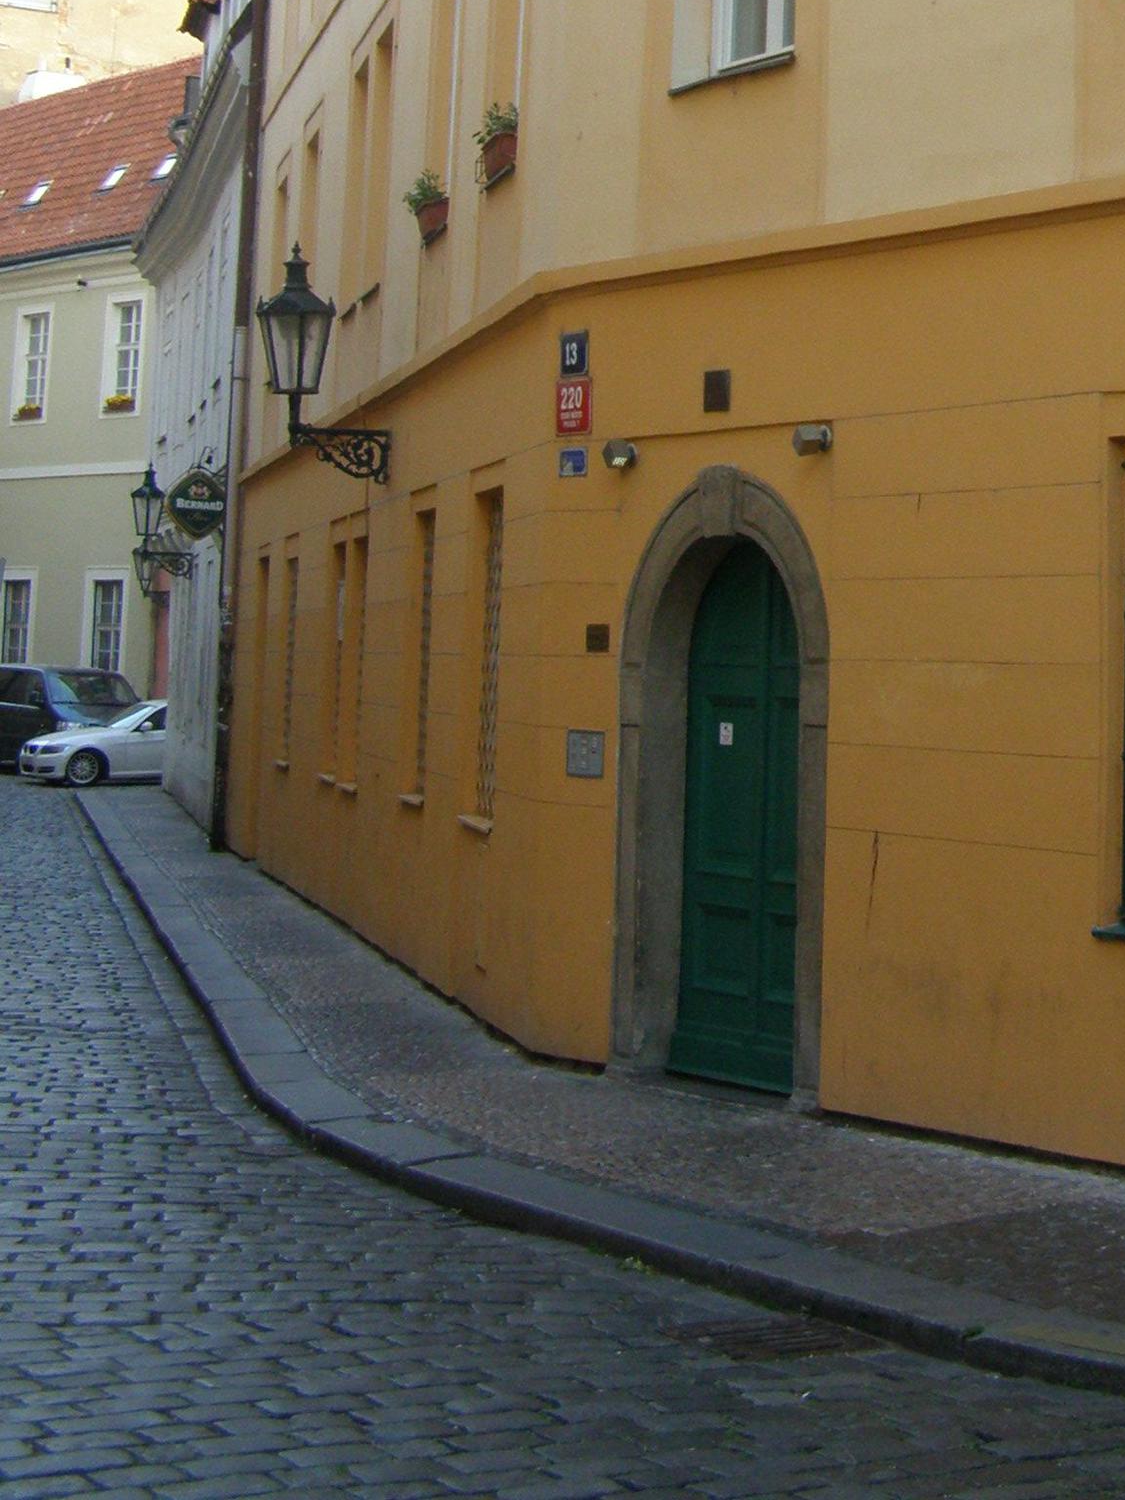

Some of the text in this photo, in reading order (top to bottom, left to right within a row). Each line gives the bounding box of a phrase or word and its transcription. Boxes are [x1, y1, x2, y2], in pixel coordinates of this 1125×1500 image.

[565, 342, 578, 366] 13
[560, 386, 583, 410] 220
[176, 497, 224, 511] BERNARD
